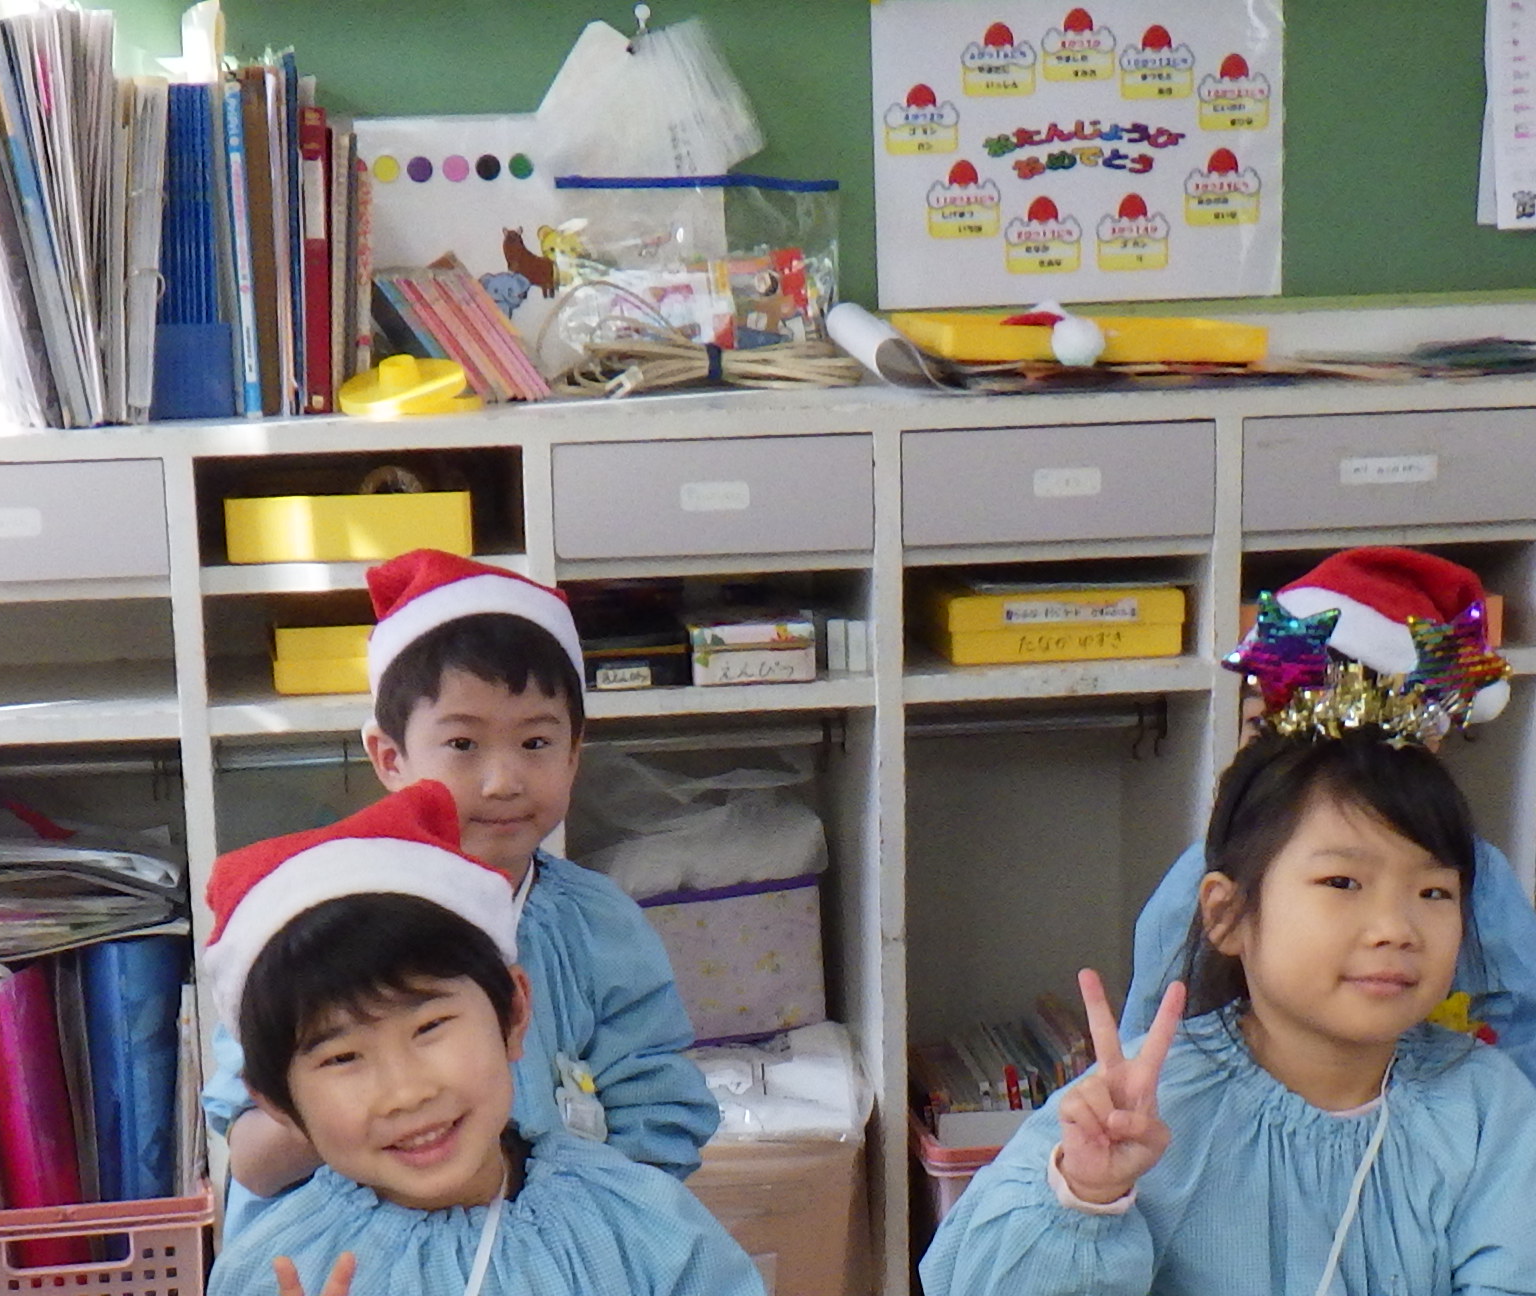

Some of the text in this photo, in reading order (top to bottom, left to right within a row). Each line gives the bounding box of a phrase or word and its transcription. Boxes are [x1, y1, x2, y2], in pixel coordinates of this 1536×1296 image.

[1012, 145, 1154, 179] おめでとう
[721, 660, 794, 681] えんぴつ
